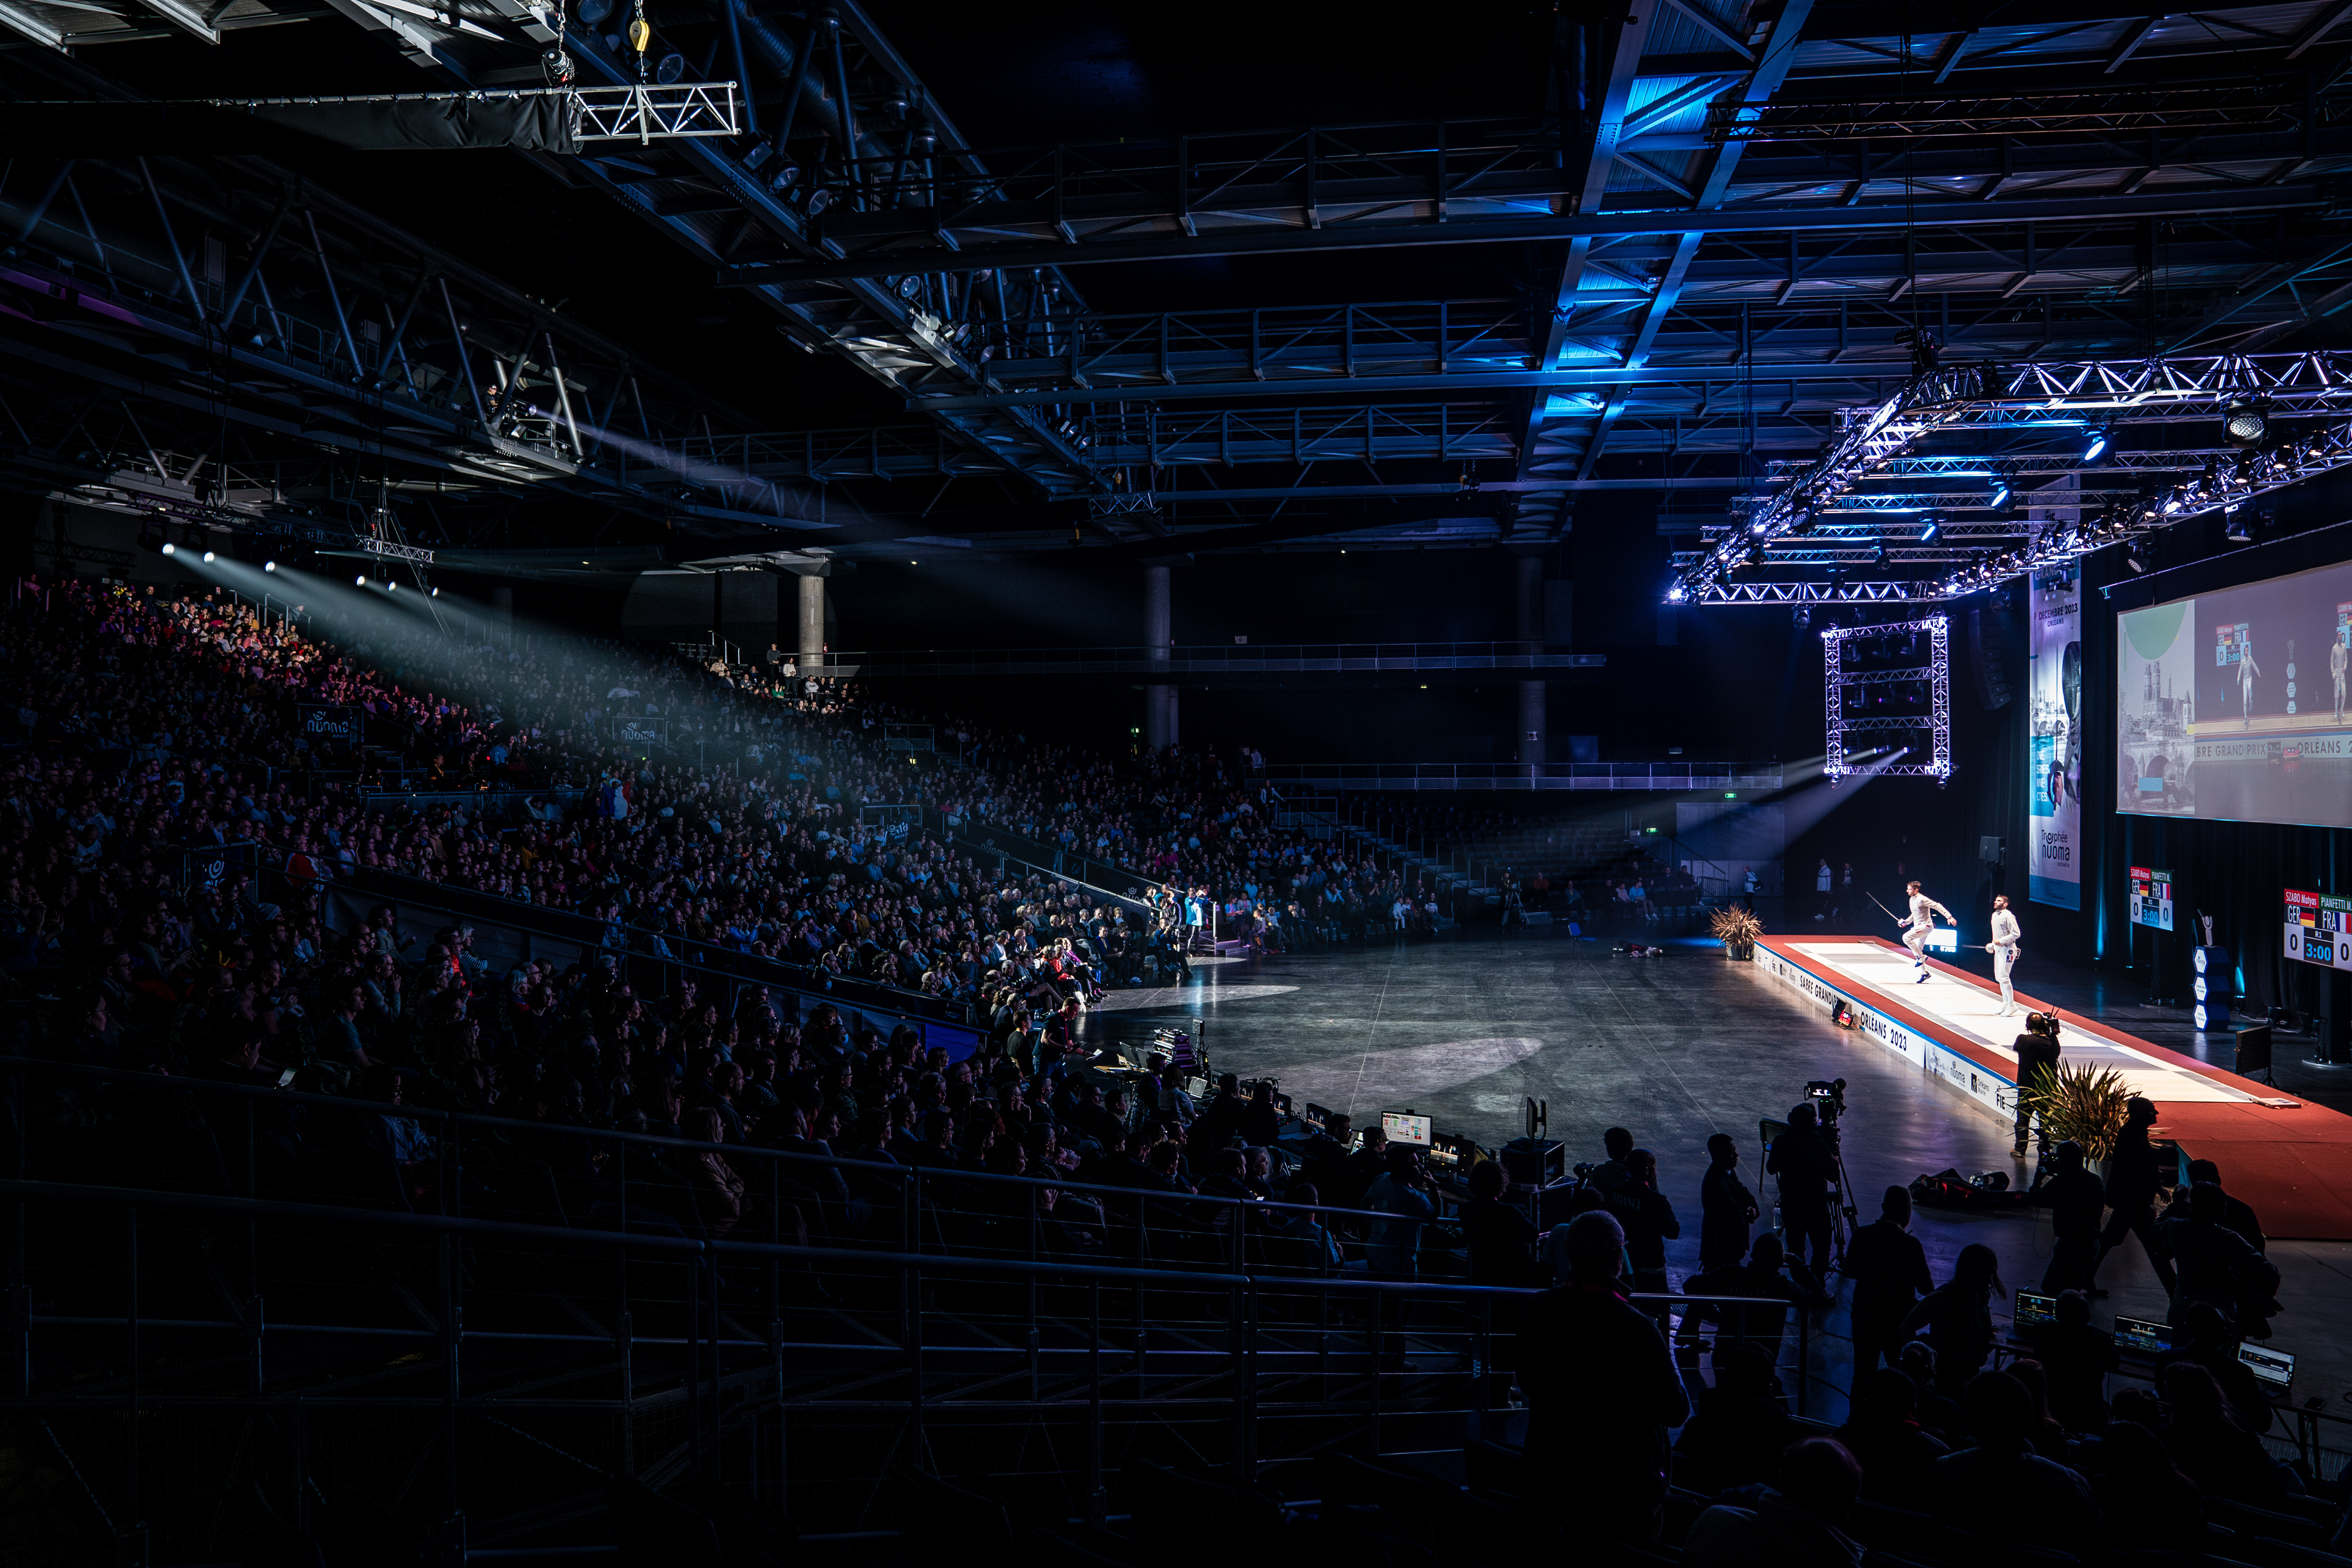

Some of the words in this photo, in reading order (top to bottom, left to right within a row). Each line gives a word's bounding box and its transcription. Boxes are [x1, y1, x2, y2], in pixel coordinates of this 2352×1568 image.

[2039, 607, 2063, 621] DÉCEMBRE
[2065, 603, 2078, 614] 2023
[2339, 613, 2348, 626] GER
[2047, 617, 2064, 627] ORLÉANS
[2220, 651, 2223, 662] 0
[2227, 653, 2239, 662] 3:00
[2215, 744, 2244, 757] GRAND
[2247, 743, 2266, 755] PRIX
[2297, 738, 2341, 755] ORLÉANS
[2042, 829, 2068, 844] Trophée
[2042, 844, 2070, 861] nuoma
[2131, 868, 2140, 877] SZABO
[2152, 882, 2161, 898] FRA
[2286, 892, 2300, 903] SZABO
[2301, 894, 2317, 907] Matyas
[2321, 897, 2346, 910] PIANFETTI
[2133, 902, 2138, 916] 0
[2143, 909, 2158, 922] 3:00
[2163, 907, 2169, 922] 0
[2288, 905, 2301, 924] GER
[2323, 911, 2337, 930] FRA
[2290, 934, 2298, 951] 0
[2306, 943, 2331, 961] 3:00
[2340, 943, 2349, 961] 0
[1800, 975, 1813, 994] SABRE
[1815, 984, 1831, 1005] GRAND
[1860, 1013, 1886, 1039] ORLÉANS
[1890, 1029, 1907, 1051] 2023
[1950, 1067, 1965, 1083] nuoma
[1977, 1079, 1989, 1092] Orléans
[1996, 1093, 2005, 1110] FIE
[1613, 1192, 1643, 1210] FRANCE
